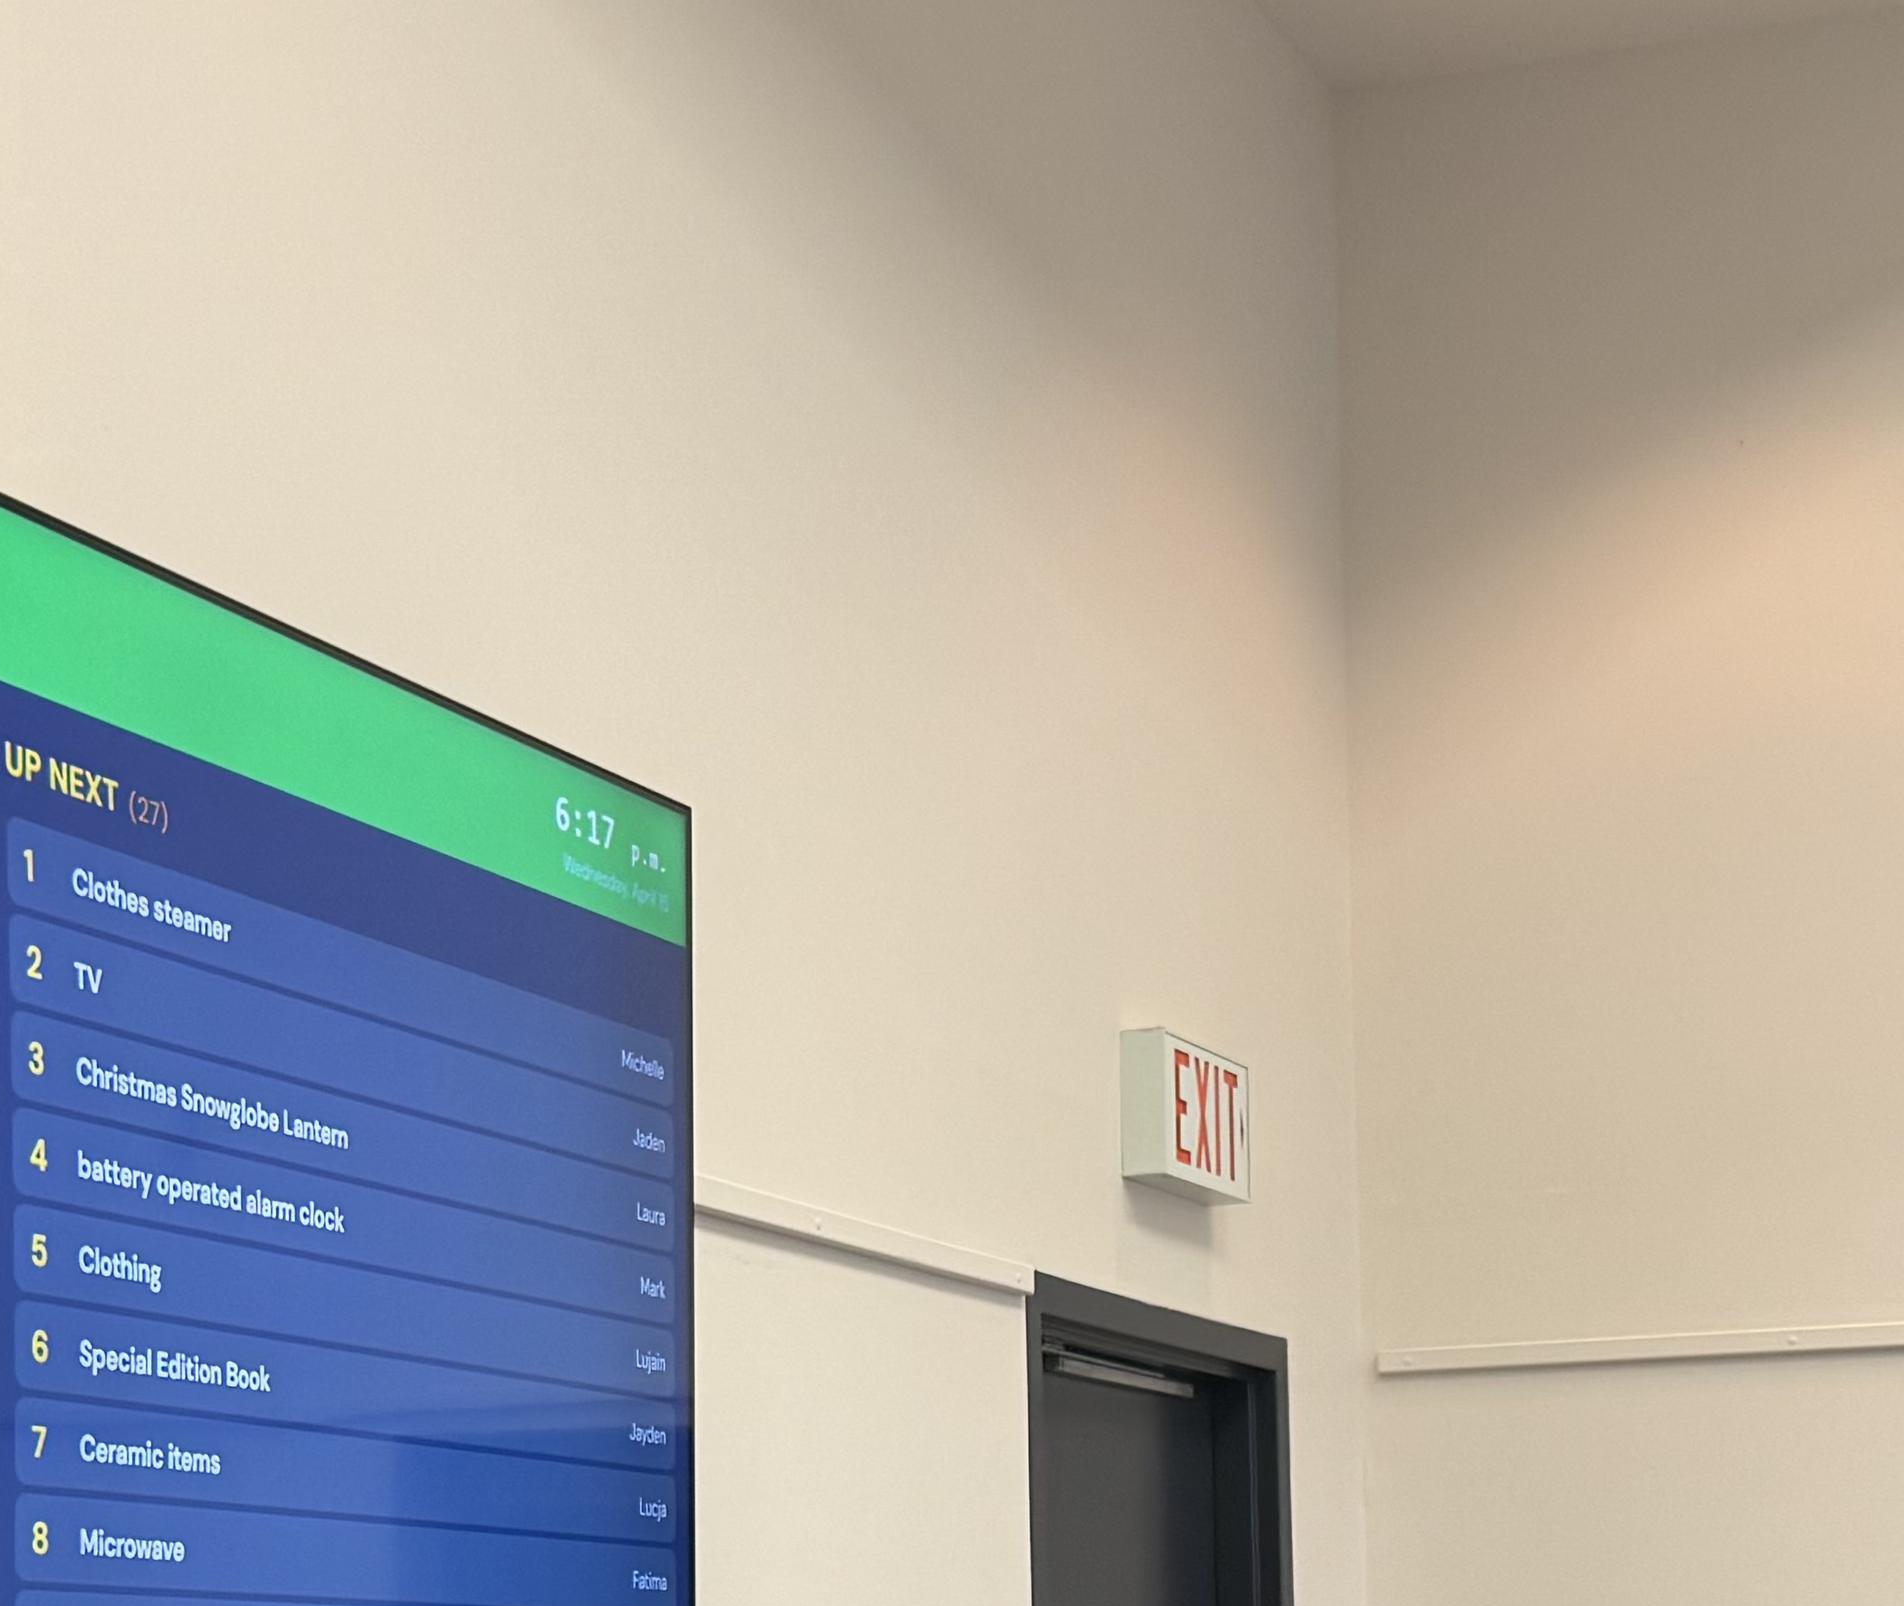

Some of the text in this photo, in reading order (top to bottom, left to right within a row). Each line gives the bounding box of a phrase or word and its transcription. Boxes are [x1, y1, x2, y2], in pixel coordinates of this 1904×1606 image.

[4, 740, 168, 834] UP NEXT (27)
[555, 796, 666, 873] 6:17 p.m.
[22, 848, 232, 943] 1 Clothes steamer
[25, 944, 103, 995] 2 TV
[620, 1049, 665, 1081] Michelle
[28, 1040, 349, 1150] 3 Christmas Snowglobe Lantern
[1173, 1047, 1239, 1182] EXIT
[632, 1127, 666, 1153] Jaden
[29, 1138, 345, 1234] 4 battery operated alarm clock
[636, 1201, 666, 1227] Laura
[30, 1233, 162, 1294] 5 Clothing
[639, 1275, 666, 1299] Mark
[31, 1329, 271, 1393] 6 Special Edition Book
[635, 1348, 666, 1375] Lujain
[31, 1425, 221, 1475] 7 Ceramic items
[628, 1422, 667, 1446] Jayden
[638, 1497, 667, 1522] Lucja
[31, 1520, 185, 1562] 8 Microwave
[632, 1570, 668, 1591] Fatima
